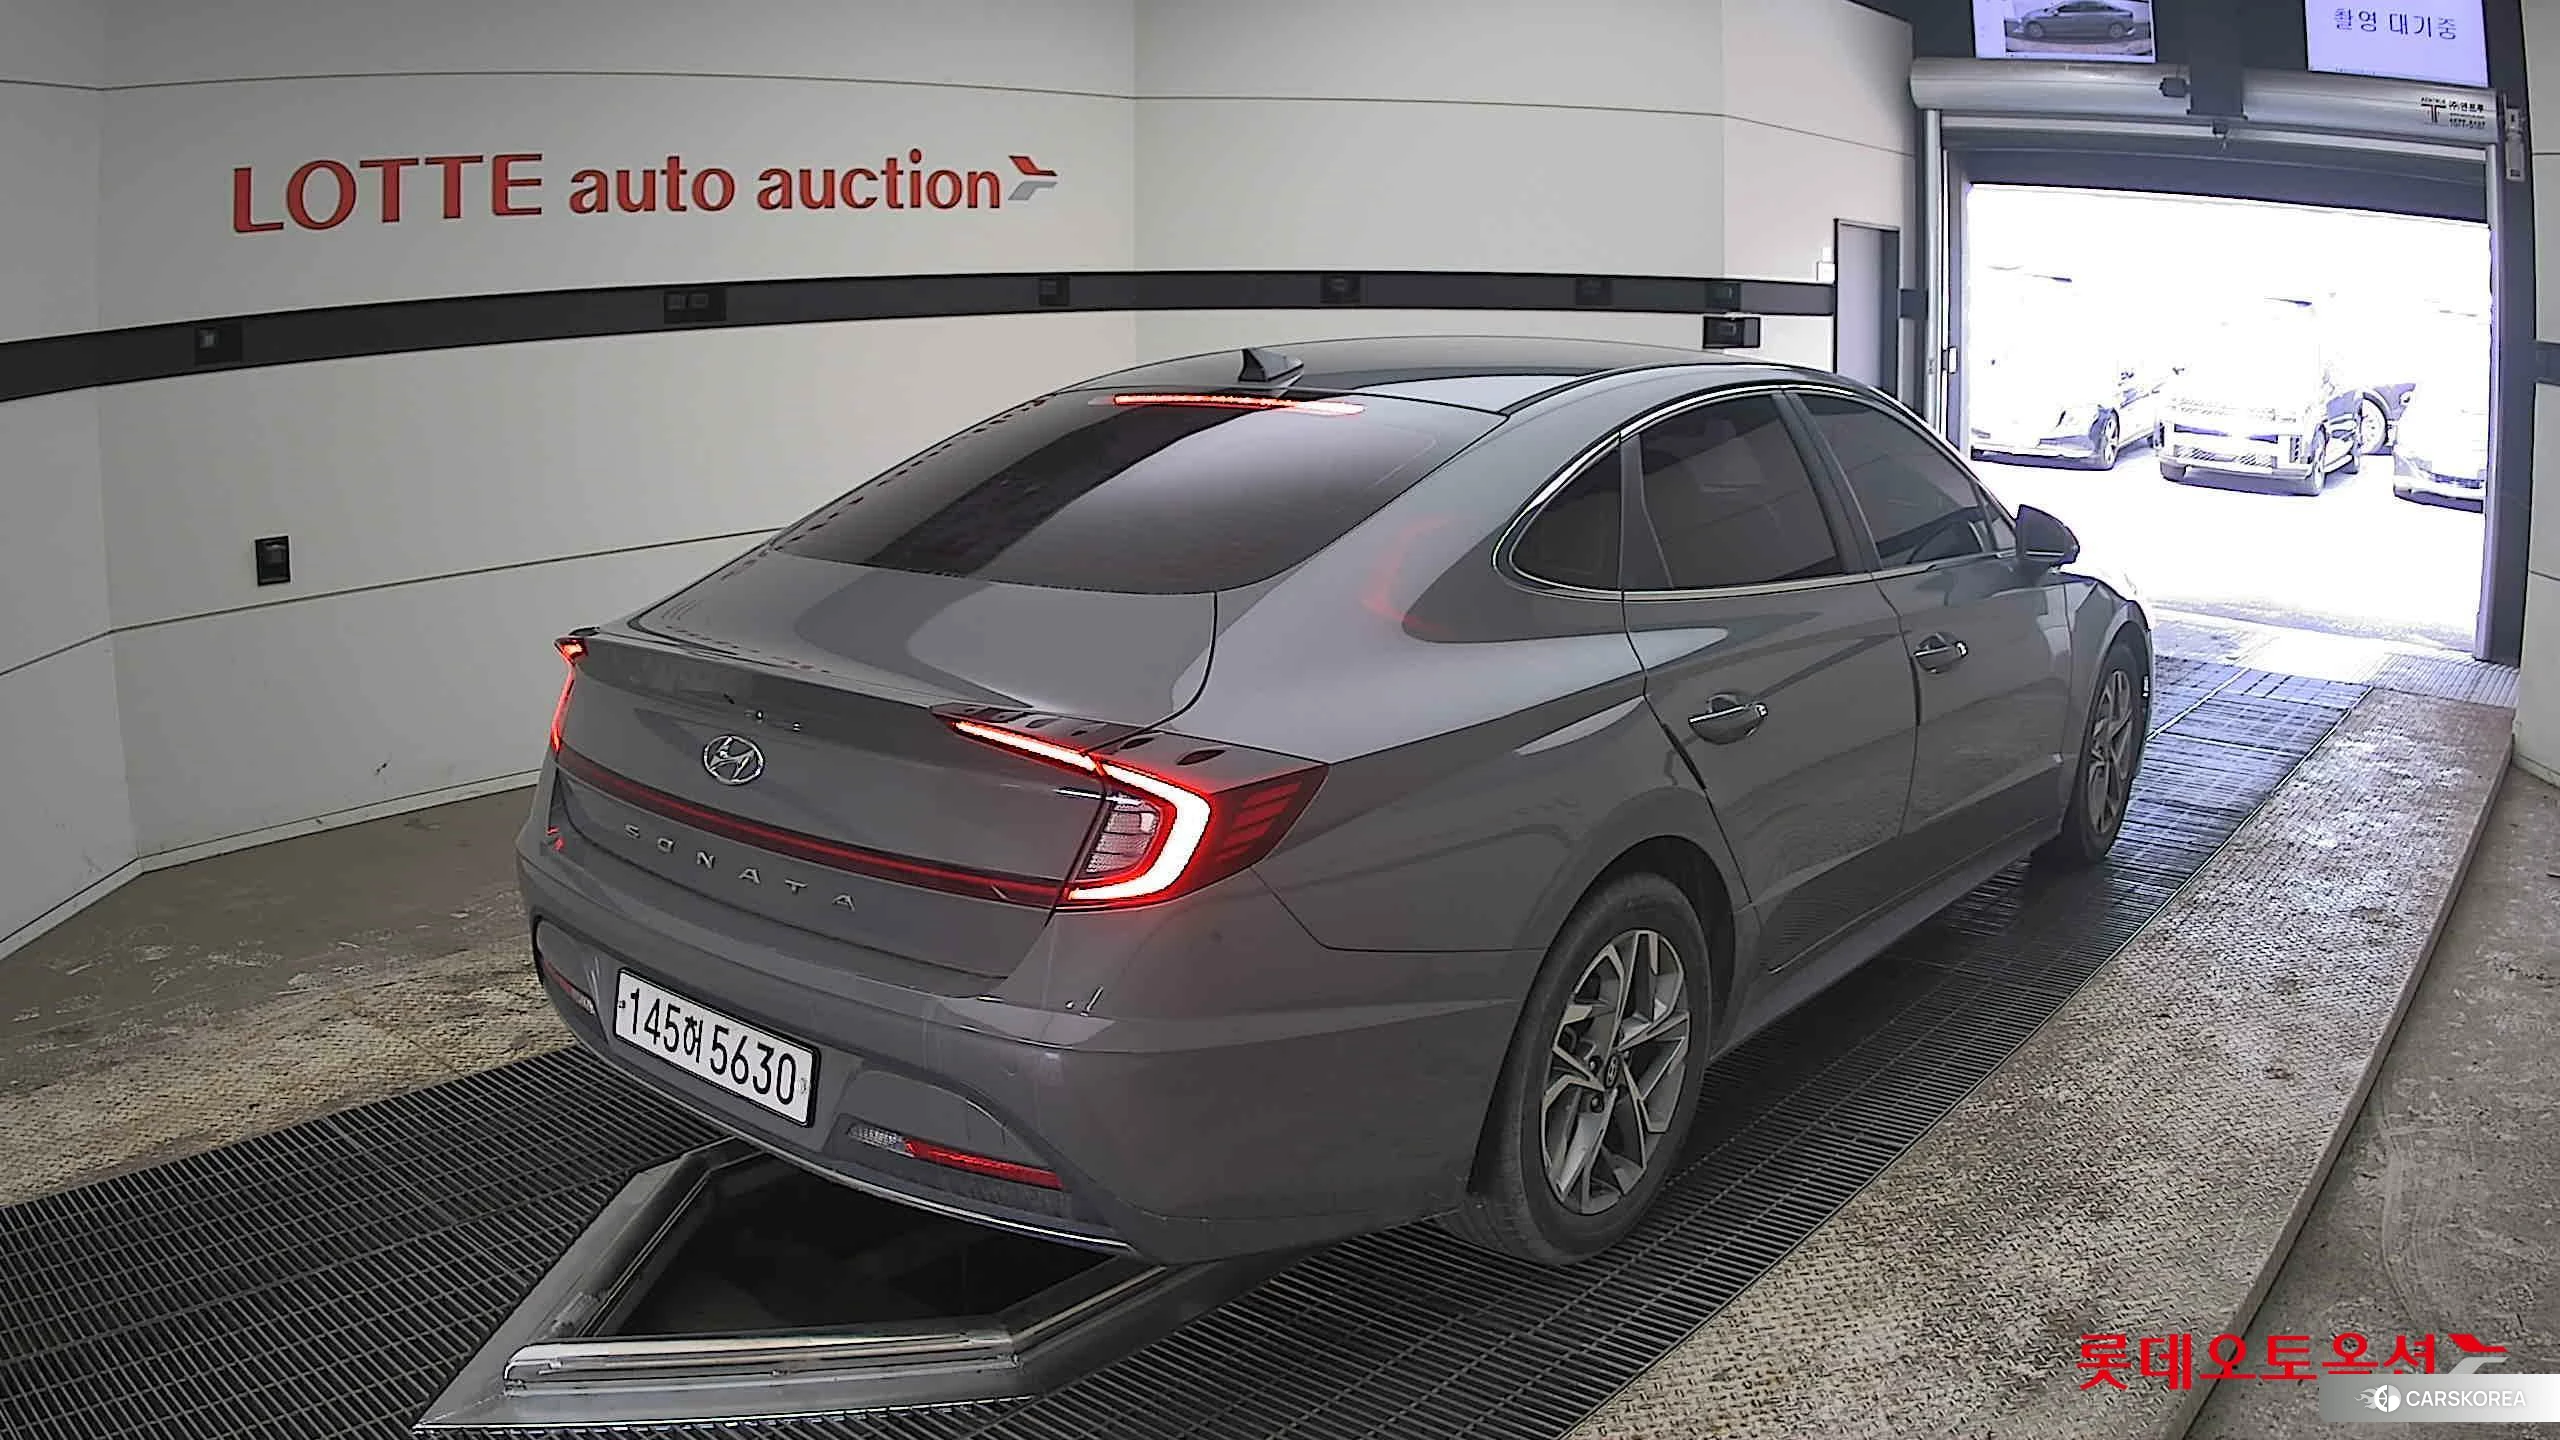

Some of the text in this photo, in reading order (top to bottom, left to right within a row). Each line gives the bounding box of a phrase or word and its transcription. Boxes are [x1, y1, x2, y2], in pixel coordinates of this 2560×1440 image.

[2335, 8, 2457, 40] 촬영 대기중
[233, 148, 1001, 233] LOTTE auto auction
[623, 822, 856, 912] SONATA
[630, 988, 796, 1105] 145허 5630
